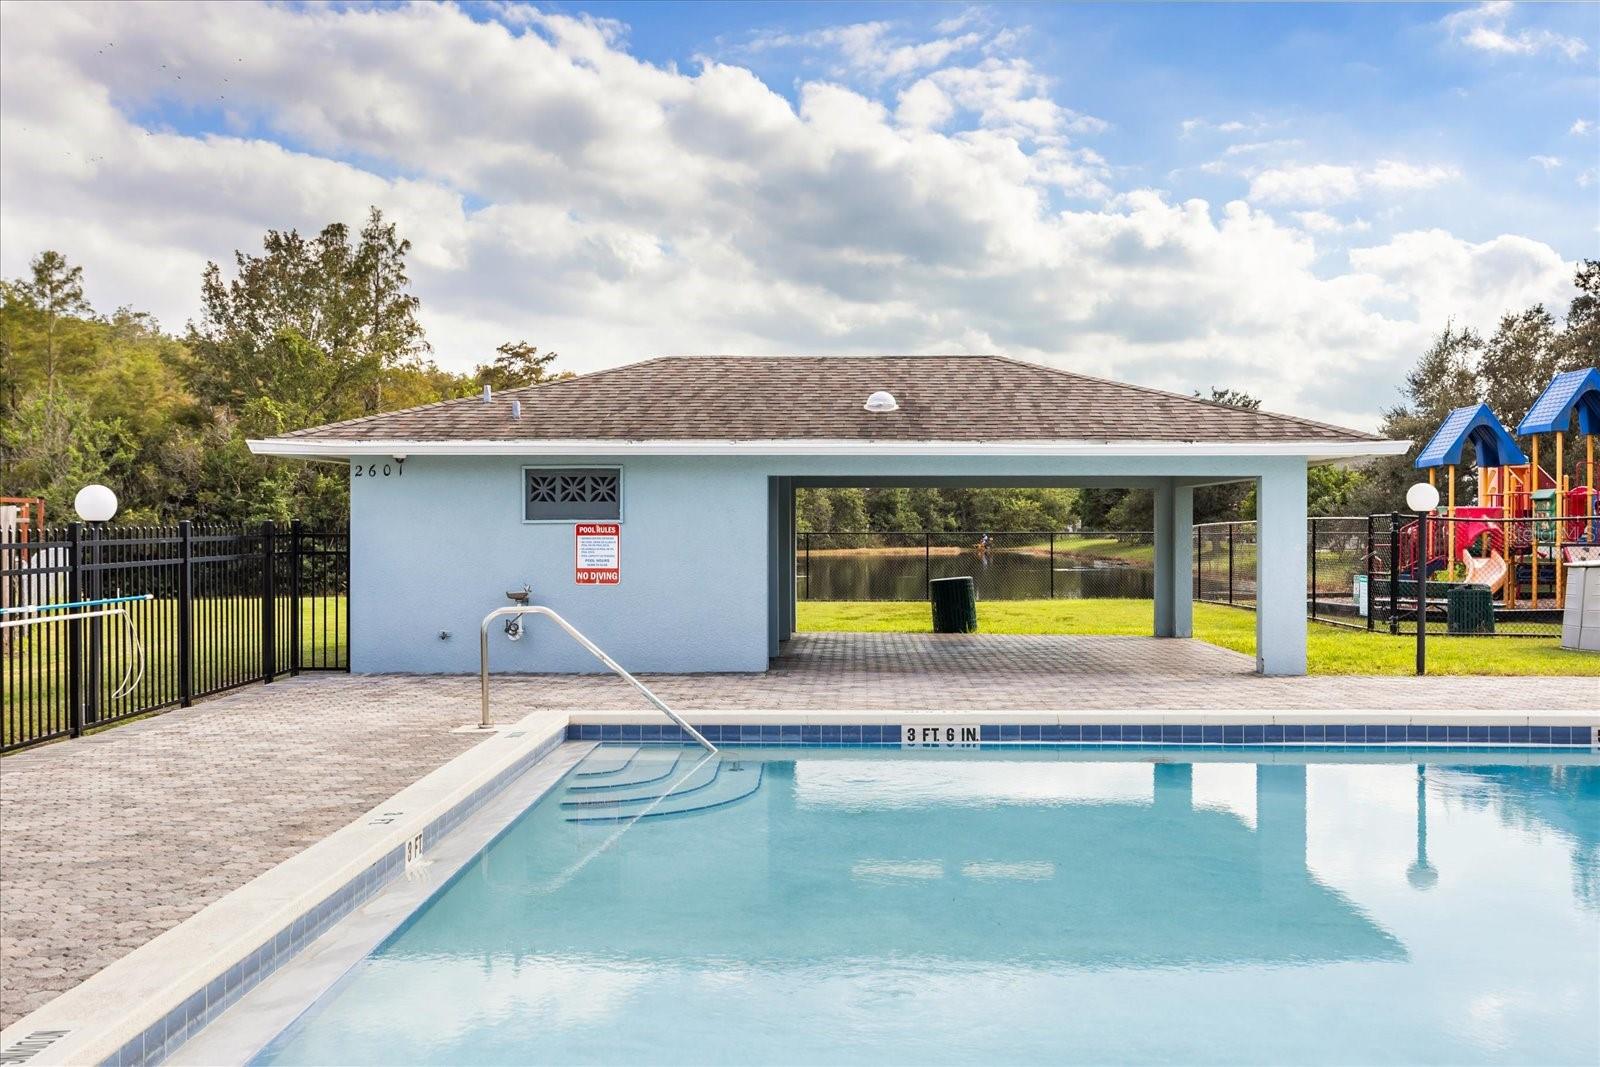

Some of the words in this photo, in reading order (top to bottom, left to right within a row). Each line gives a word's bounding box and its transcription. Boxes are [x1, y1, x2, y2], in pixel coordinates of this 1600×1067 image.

[355, 464, 403, 477] 2601
[577, 571, 589, 580] NO
[590, 571, 618, 580] DIVING
[907, 727, 916, 742] 3
[922, 727, 940, 742] FT.
[946, 727, 955, 742] 6
[961, 727, 979, 742] IN.
[407, 841, 413, 863] 3
[414, 834, 423, 859] FT
